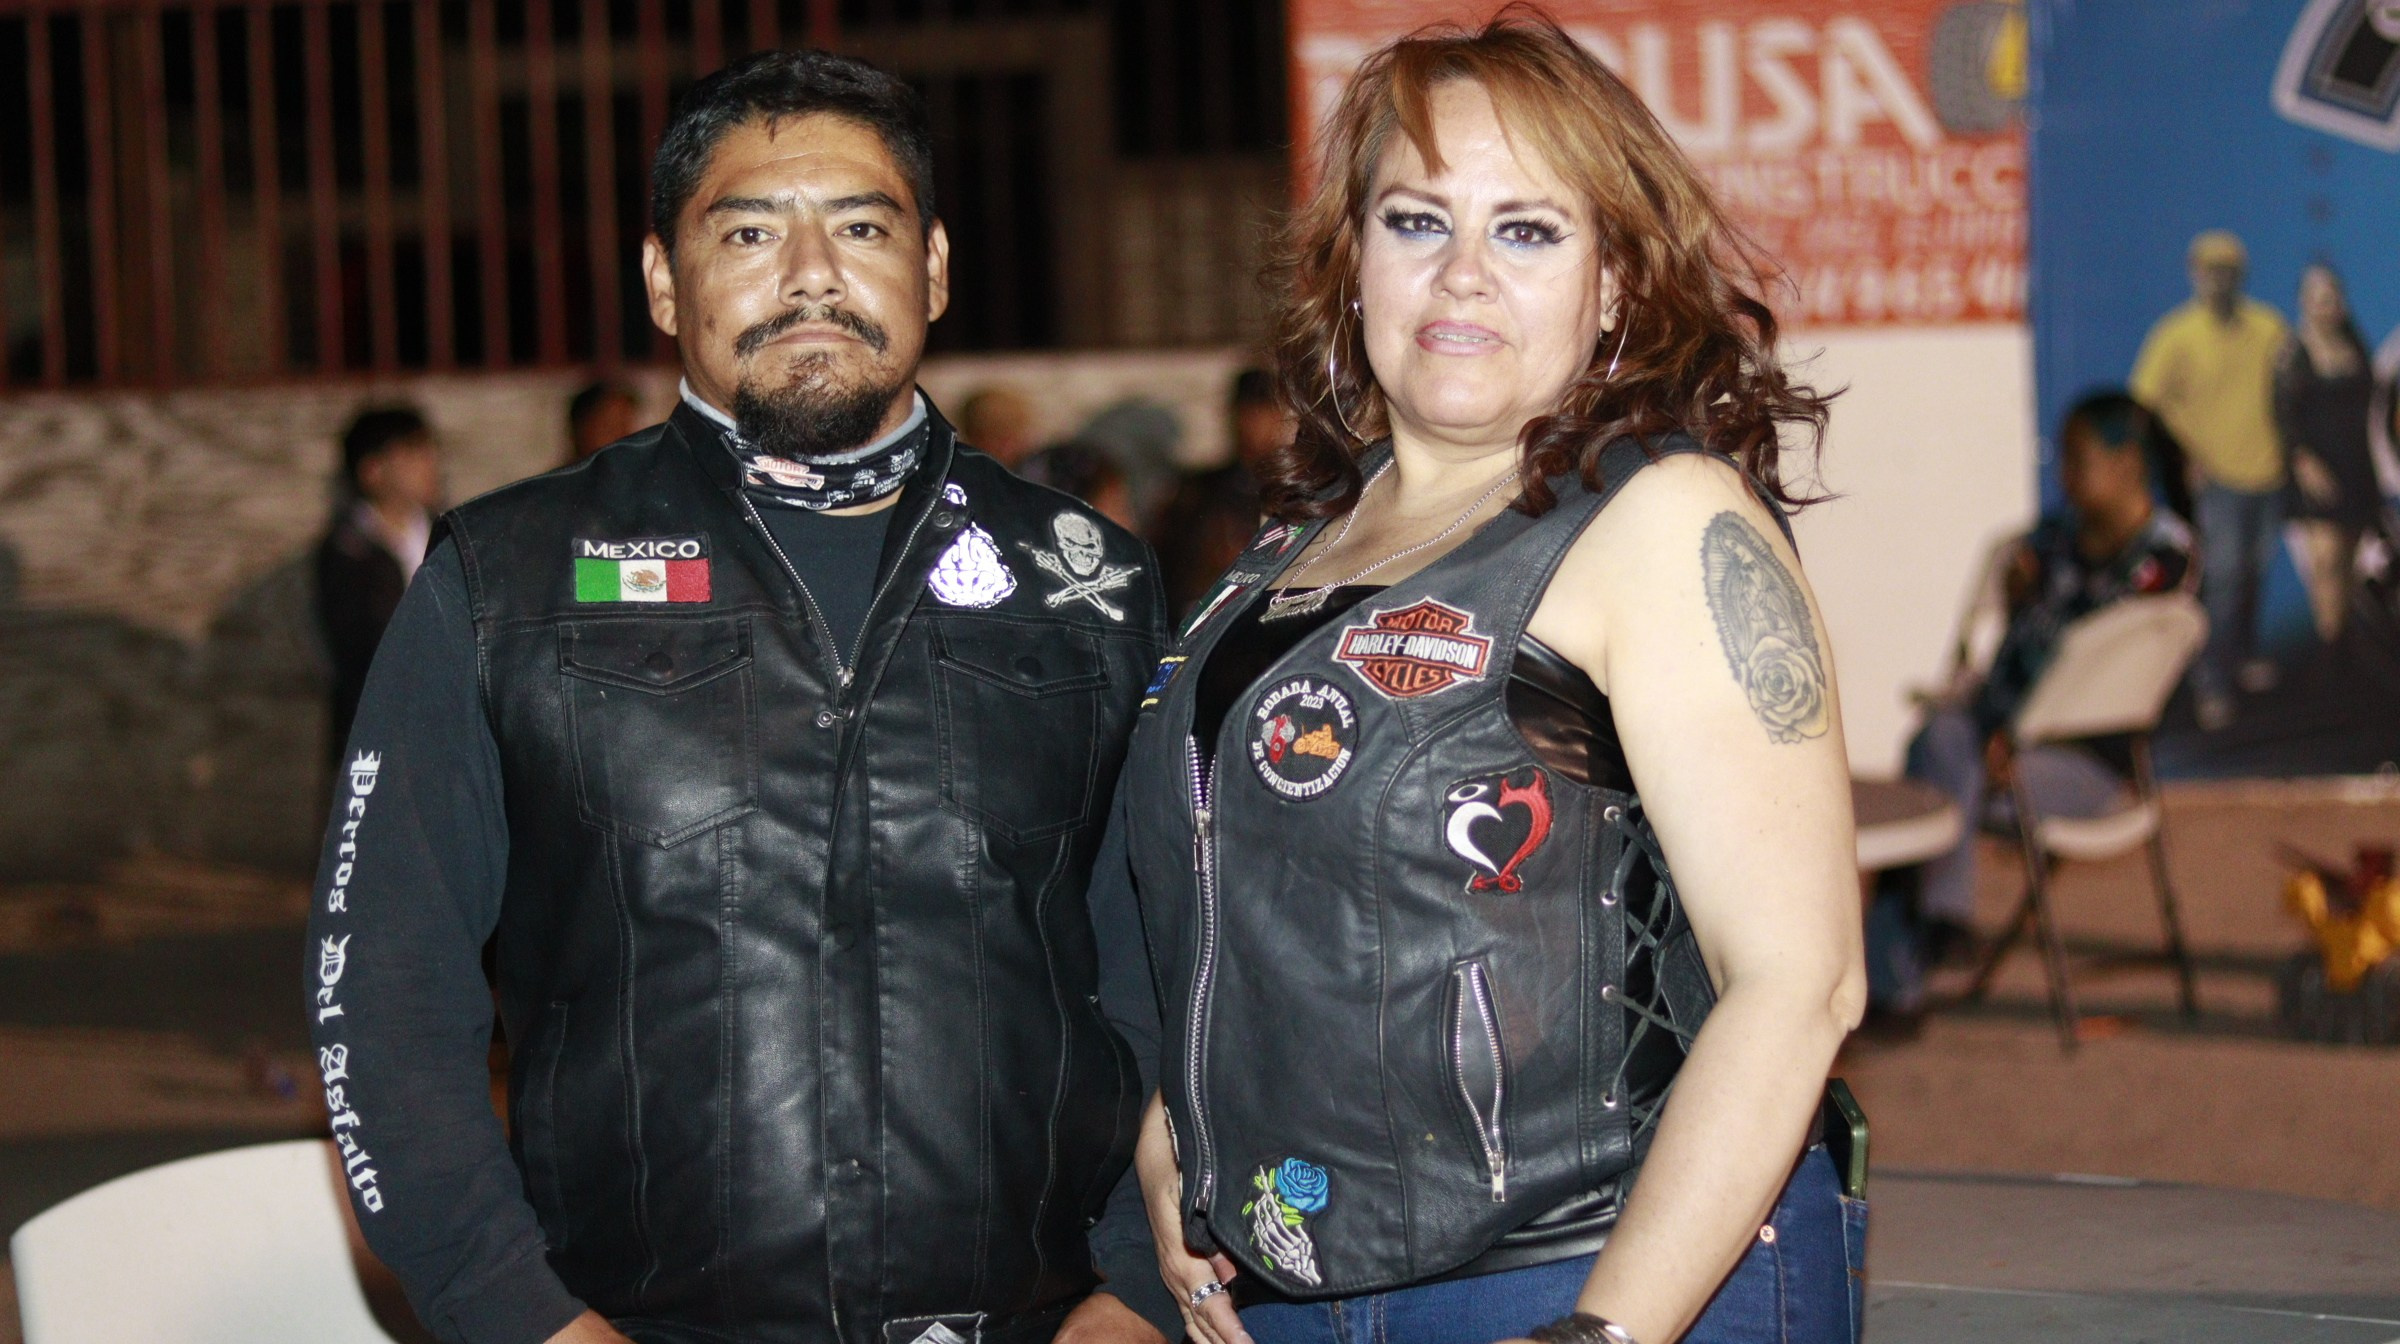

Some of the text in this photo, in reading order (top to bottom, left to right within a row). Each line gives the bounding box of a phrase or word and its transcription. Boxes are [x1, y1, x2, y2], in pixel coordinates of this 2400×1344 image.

[1572, 16, 1948, 152] USA
[584, 540, 700, 558] MEXICO
[1387, 608, 1453, 633] MOTOR
[1348, 633, 1479, 669] HARLEY-DAVIDSON
[1372, 661, 1441, 690] CYCLES
[1257, 680, 1354, 728] RODADA ANUAL
[1299, 694, 1324, 709] 2023
[1252, 740, 1351, 797] DE CONCIENTIZACION
[317, 934, 352, 1025] Del
[320, 1043, 385, 1214] Asfalto
